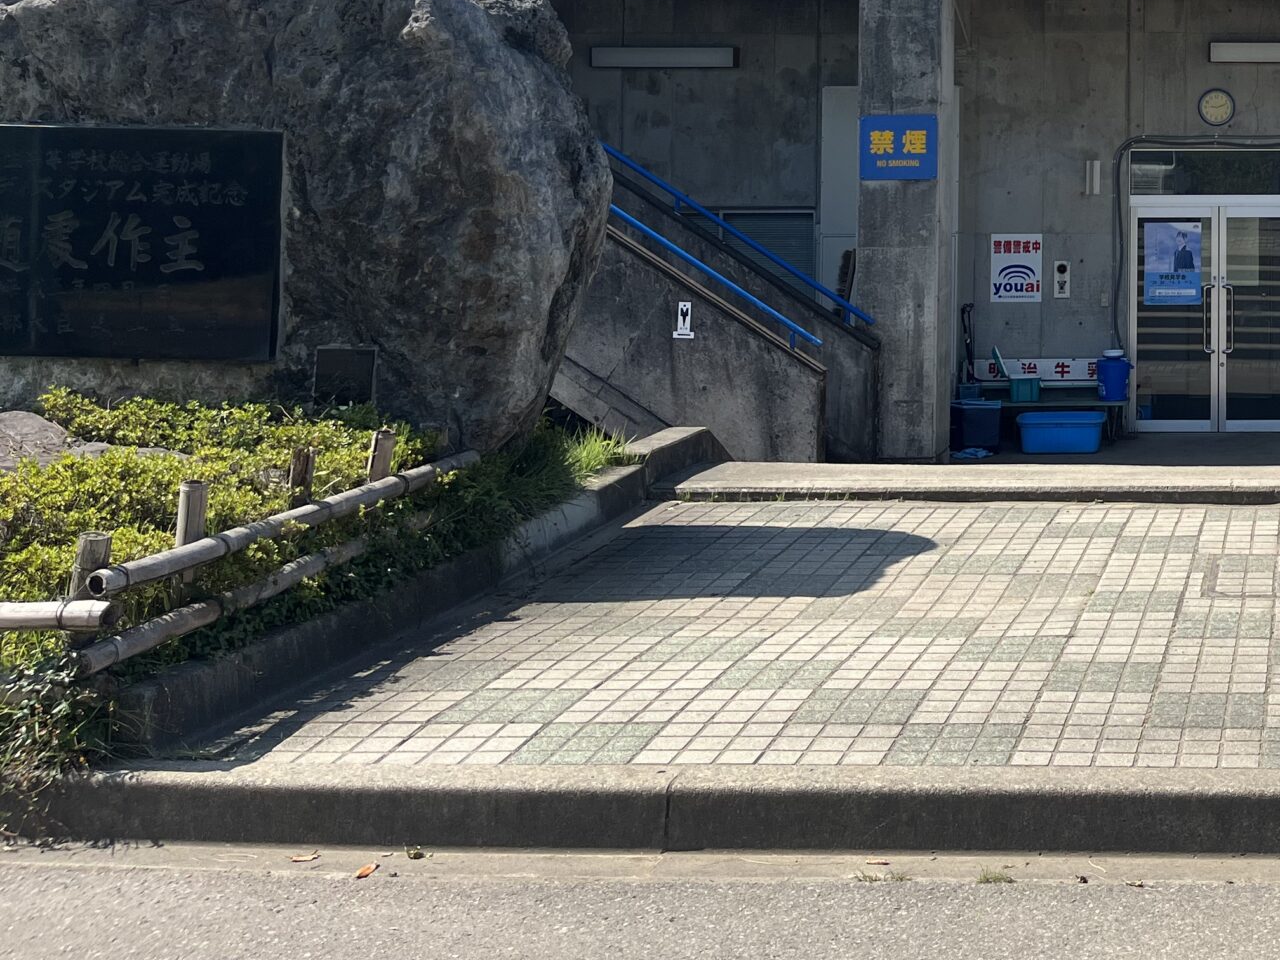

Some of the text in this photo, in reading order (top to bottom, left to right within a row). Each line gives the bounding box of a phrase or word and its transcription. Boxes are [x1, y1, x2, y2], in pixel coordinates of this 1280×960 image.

[869, 129, 928, 155] 禁煙
[876, 159, 920, 168] NO SMOKING
[993, 279, 1041, 296] youai
